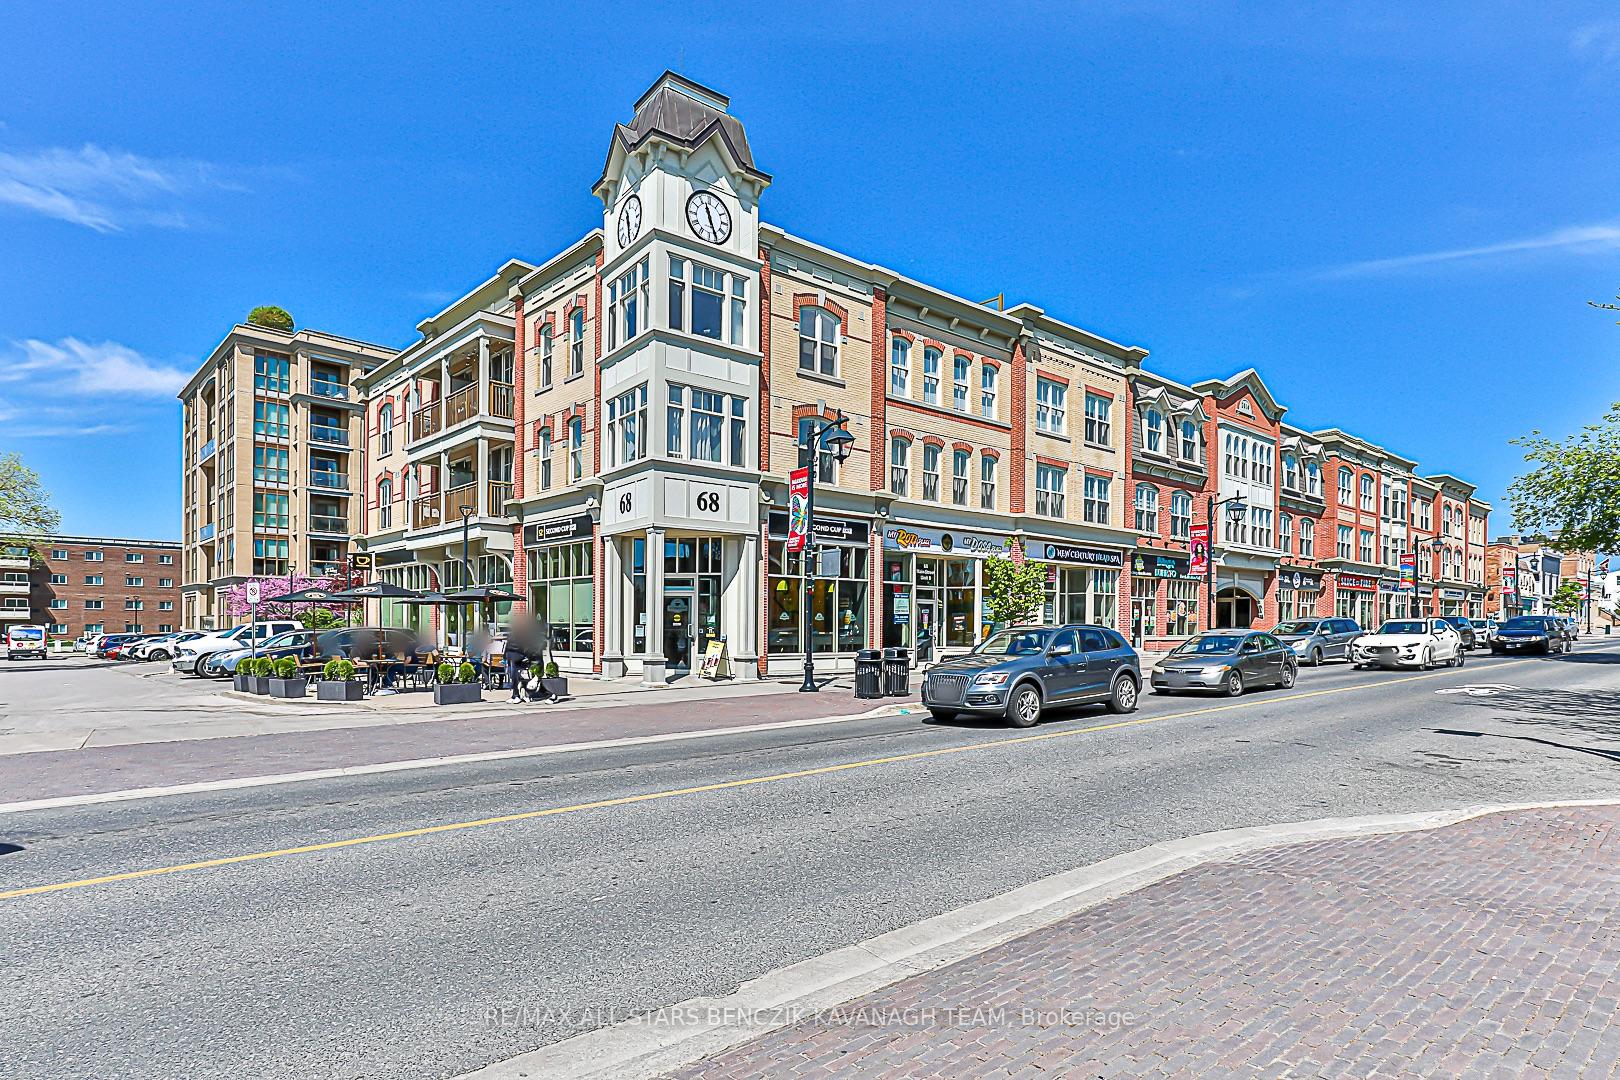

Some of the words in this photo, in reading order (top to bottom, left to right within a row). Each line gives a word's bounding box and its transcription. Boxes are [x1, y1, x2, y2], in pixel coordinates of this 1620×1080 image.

[620, 492, 632, 514] 68
[697, 491, 720, 512] 68
[813, 524, 829, 532] COND
[887, 530, 898, 538] MY
[970, 537, 993, 552] DOSA
[1056, 548, 1070, 558] NEW
[1070, 550, 1095, 561] CENTURY
[1110, 555, 1120, 564] SPA
[1341, 577, 1355, 586] SLICE
